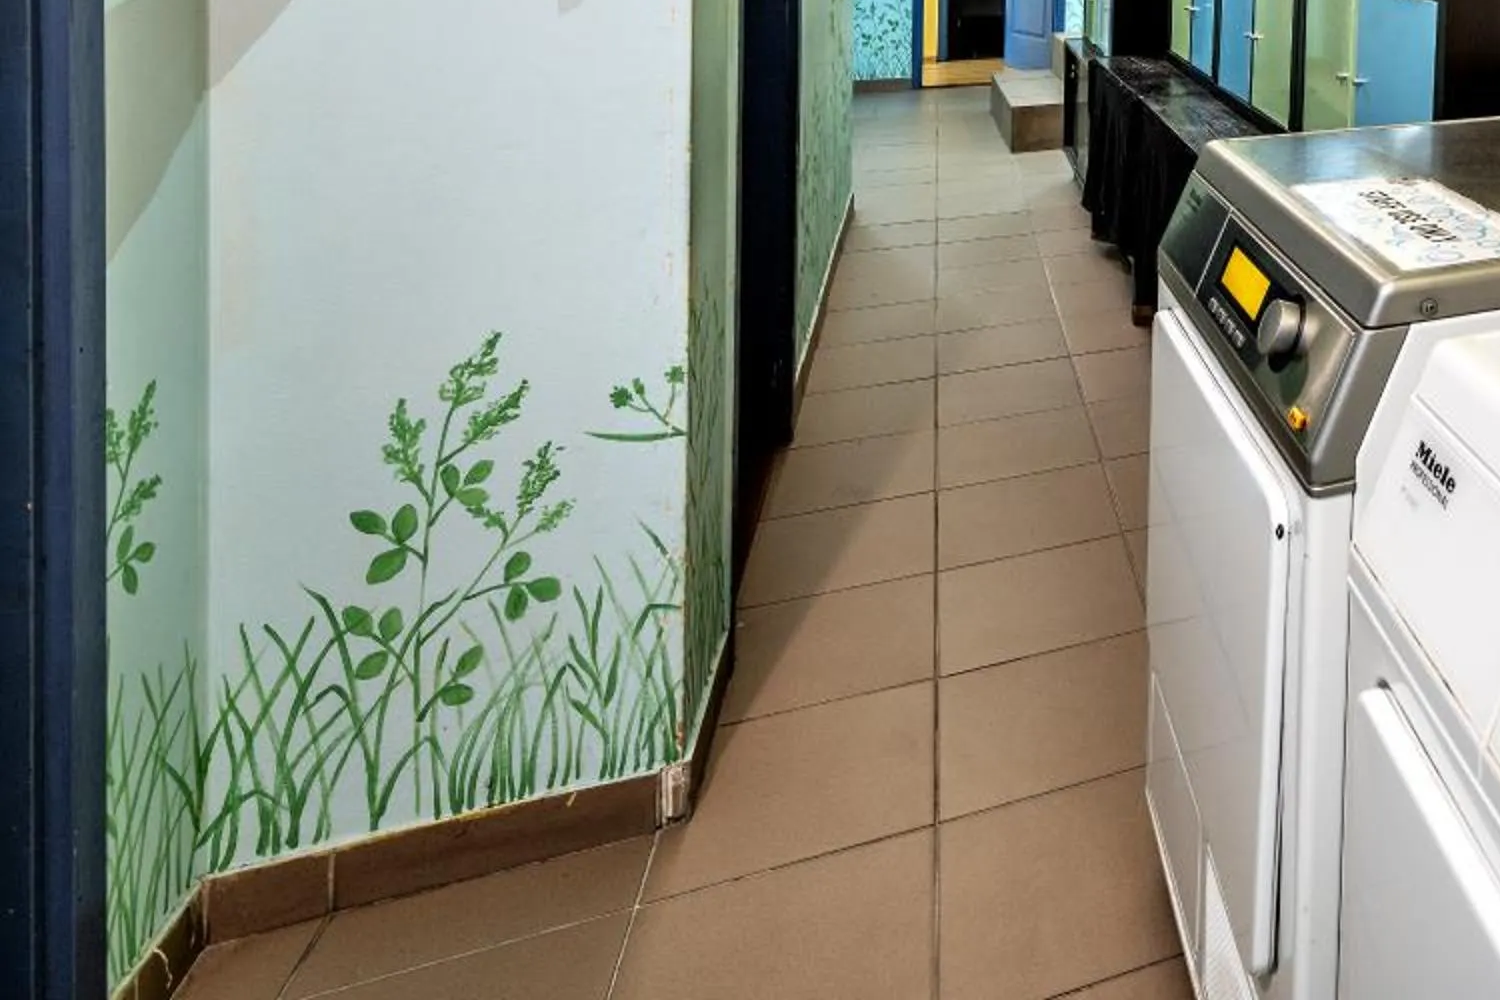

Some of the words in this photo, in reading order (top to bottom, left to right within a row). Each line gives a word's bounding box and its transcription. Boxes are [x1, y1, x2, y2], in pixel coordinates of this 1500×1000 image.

[1358, 190, 1407, 209] STAFF
[1388, 209, 1428, 224] USE
[1410, 223, 1462, 242] ONLY
[1415, 440, 1456, 493] Miele
